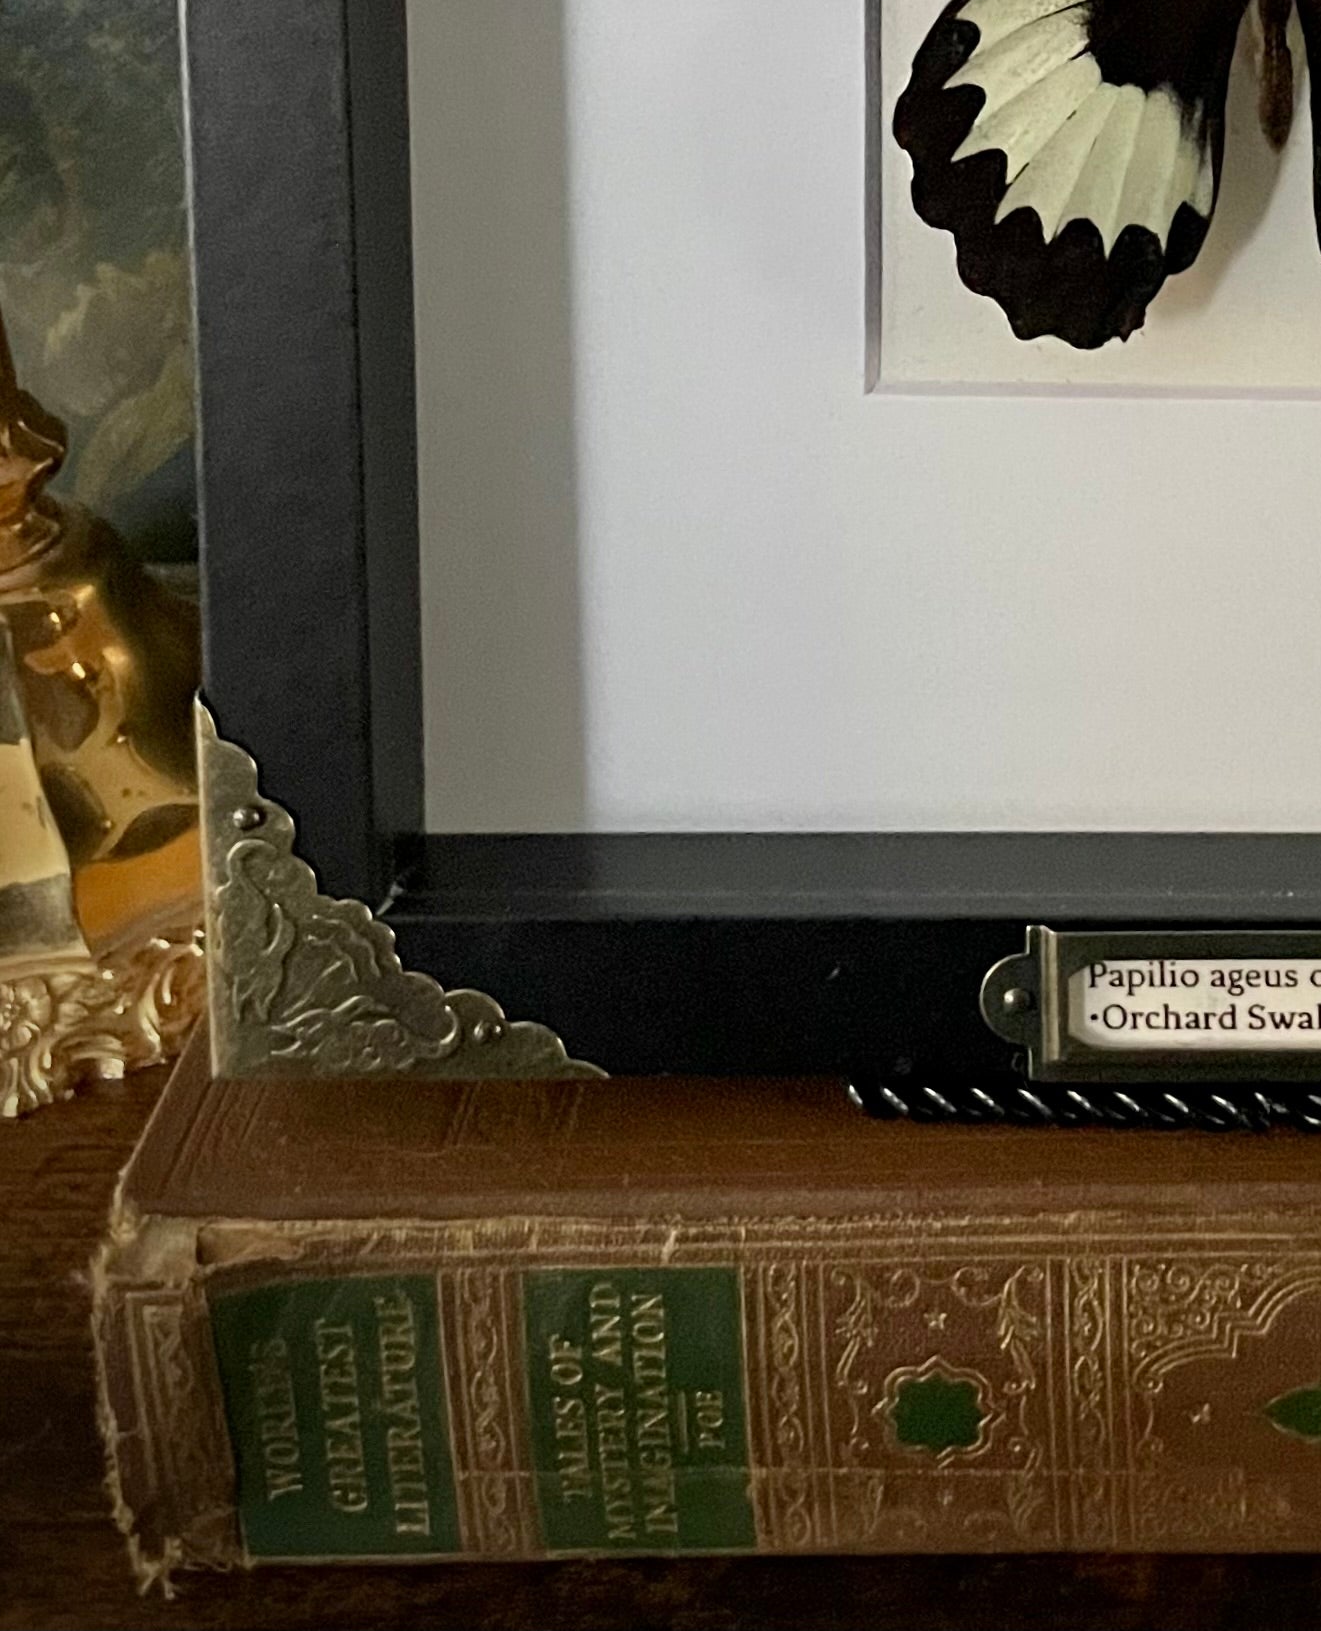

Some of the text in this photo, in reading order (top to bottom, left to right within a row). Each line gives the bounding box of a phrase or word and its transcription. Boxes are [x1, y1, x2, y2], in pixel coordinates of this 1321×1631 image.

[1088, 961, 1200, 996] Papilio
[1210, 968, 1298, 996] ageus
[315, 1317, 368, 1512] GREATEST
[374, 1287, 430, 1536] LITERATURE
[549, 1333, 592, 1503] TALES OF
[588, 1282, 636, 1539] MYSTERY AND
[630, 1293, 678, 1533] IMAGINATION
[695, 1390, 725, 1449] POE
